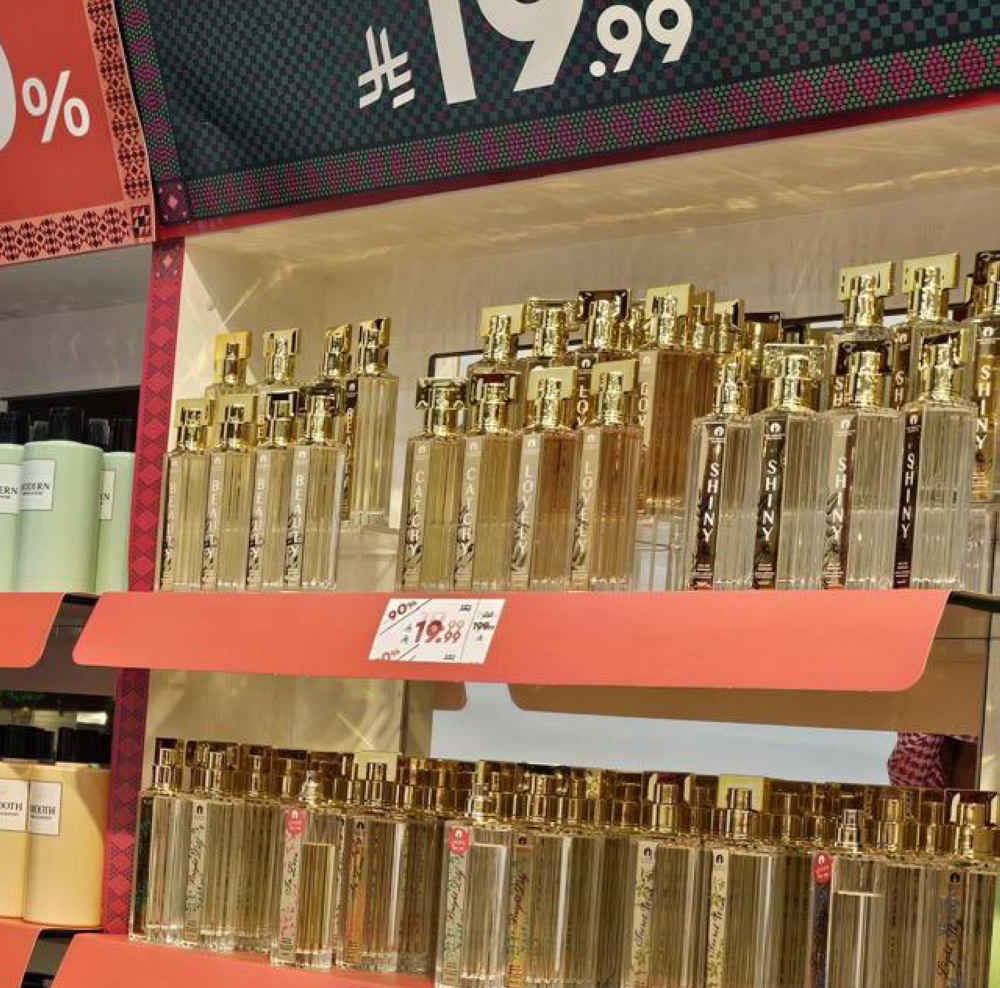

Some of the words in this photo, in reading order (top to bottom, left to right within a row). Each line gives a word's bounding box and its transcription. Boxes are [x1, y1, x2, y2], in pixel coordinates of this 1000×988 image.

[975, 365, 991, 450] SHINY
[409, 471, 425, 556] CATCHY
[461, 468, 476, 556] CATCHY
[702, 463, 720, 543] SHINY
[762, 459, 778, 542] SHINY
[832, 457, 847, 542] SHINY
[901, 452, 916, 539] SHINY
[414, 619, 462, 643] 19.99
